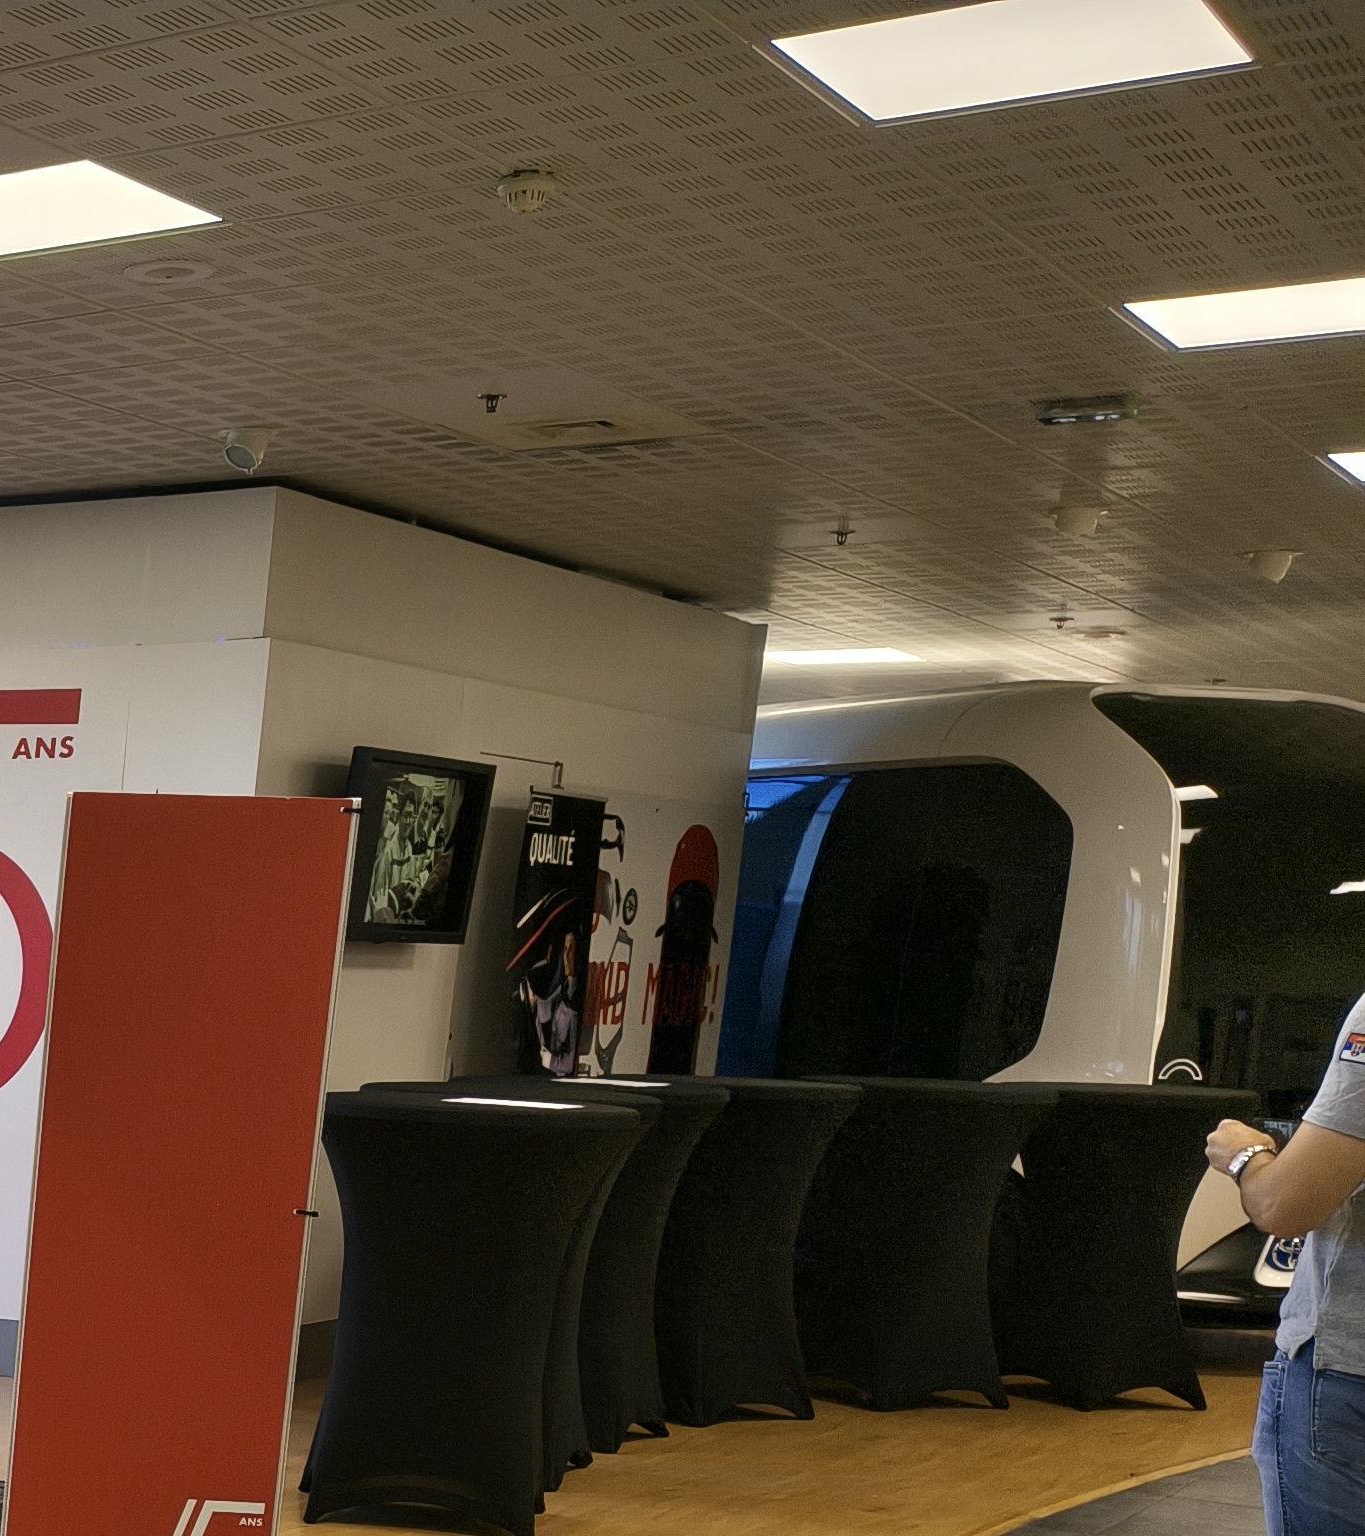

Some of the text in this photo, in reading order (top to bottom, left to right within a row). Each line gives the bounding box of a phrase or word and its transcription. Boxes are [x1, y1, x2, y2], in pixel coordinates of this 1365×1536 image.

[12, 736, 75, 760] ANS
[529, 829, 576, 867] QUALITÉ
[239, 1517, 264, 1527] ANS
